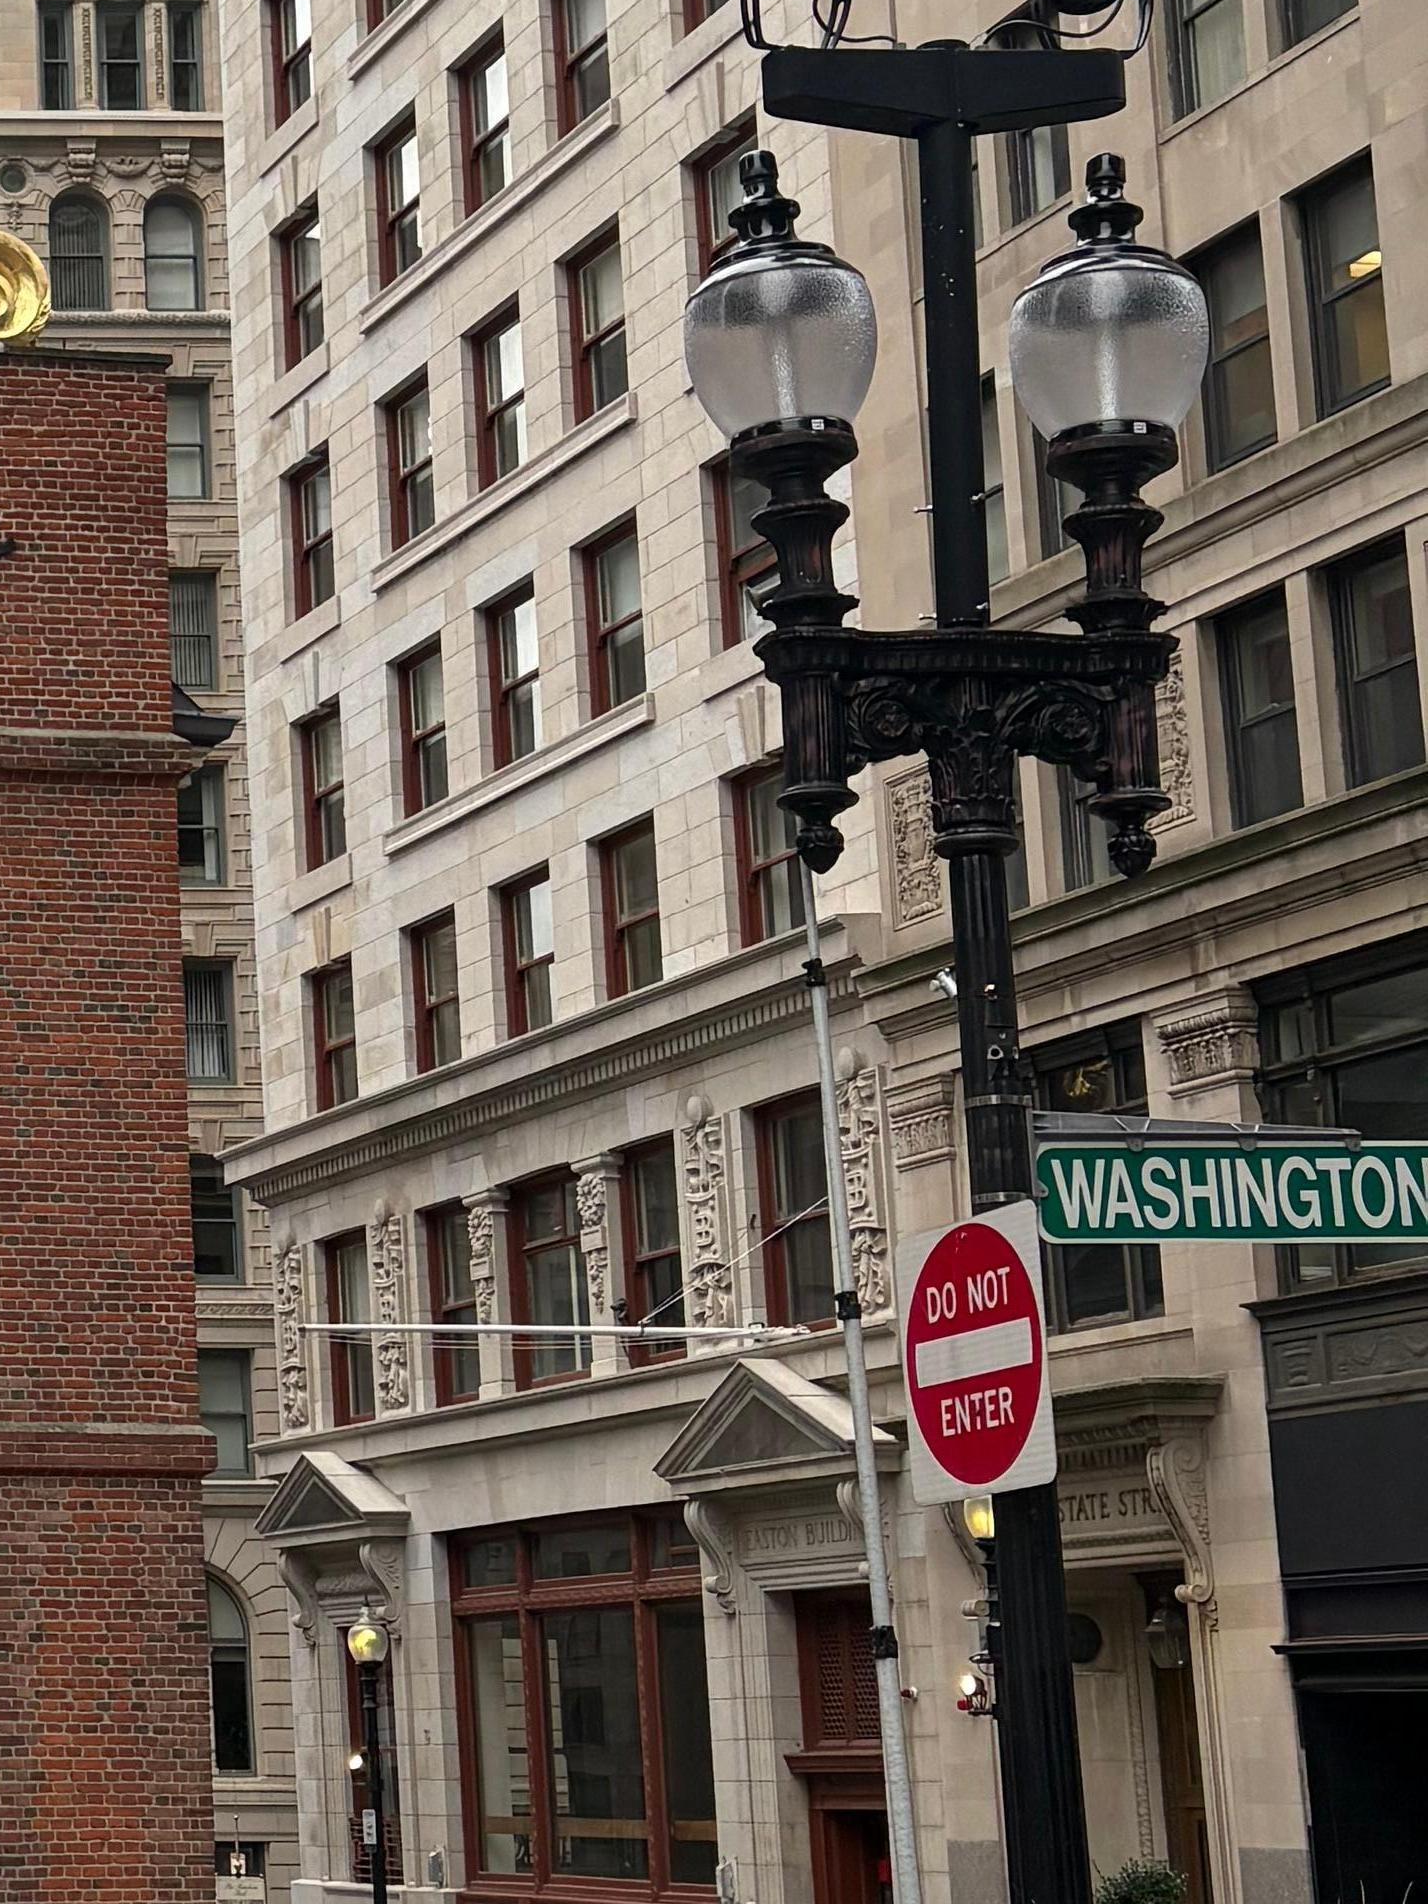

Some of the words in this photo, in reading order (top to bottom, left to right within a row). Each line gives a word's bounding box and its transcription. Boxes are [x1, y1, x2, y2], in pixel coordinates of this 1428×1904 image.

[1050, 1155, 1428, 1231] WASHINGTON
[926, 1285, 958, 1324] DO
[966, 1266, 1012, 1311] NOT
[941, 1385, 1015, 1437] ENTER
[1057, 1492, 1111, 1523] STATE
[1118, 1487, 1163, 1517] STR
[744, 1525, 798, 1552] EASTON
